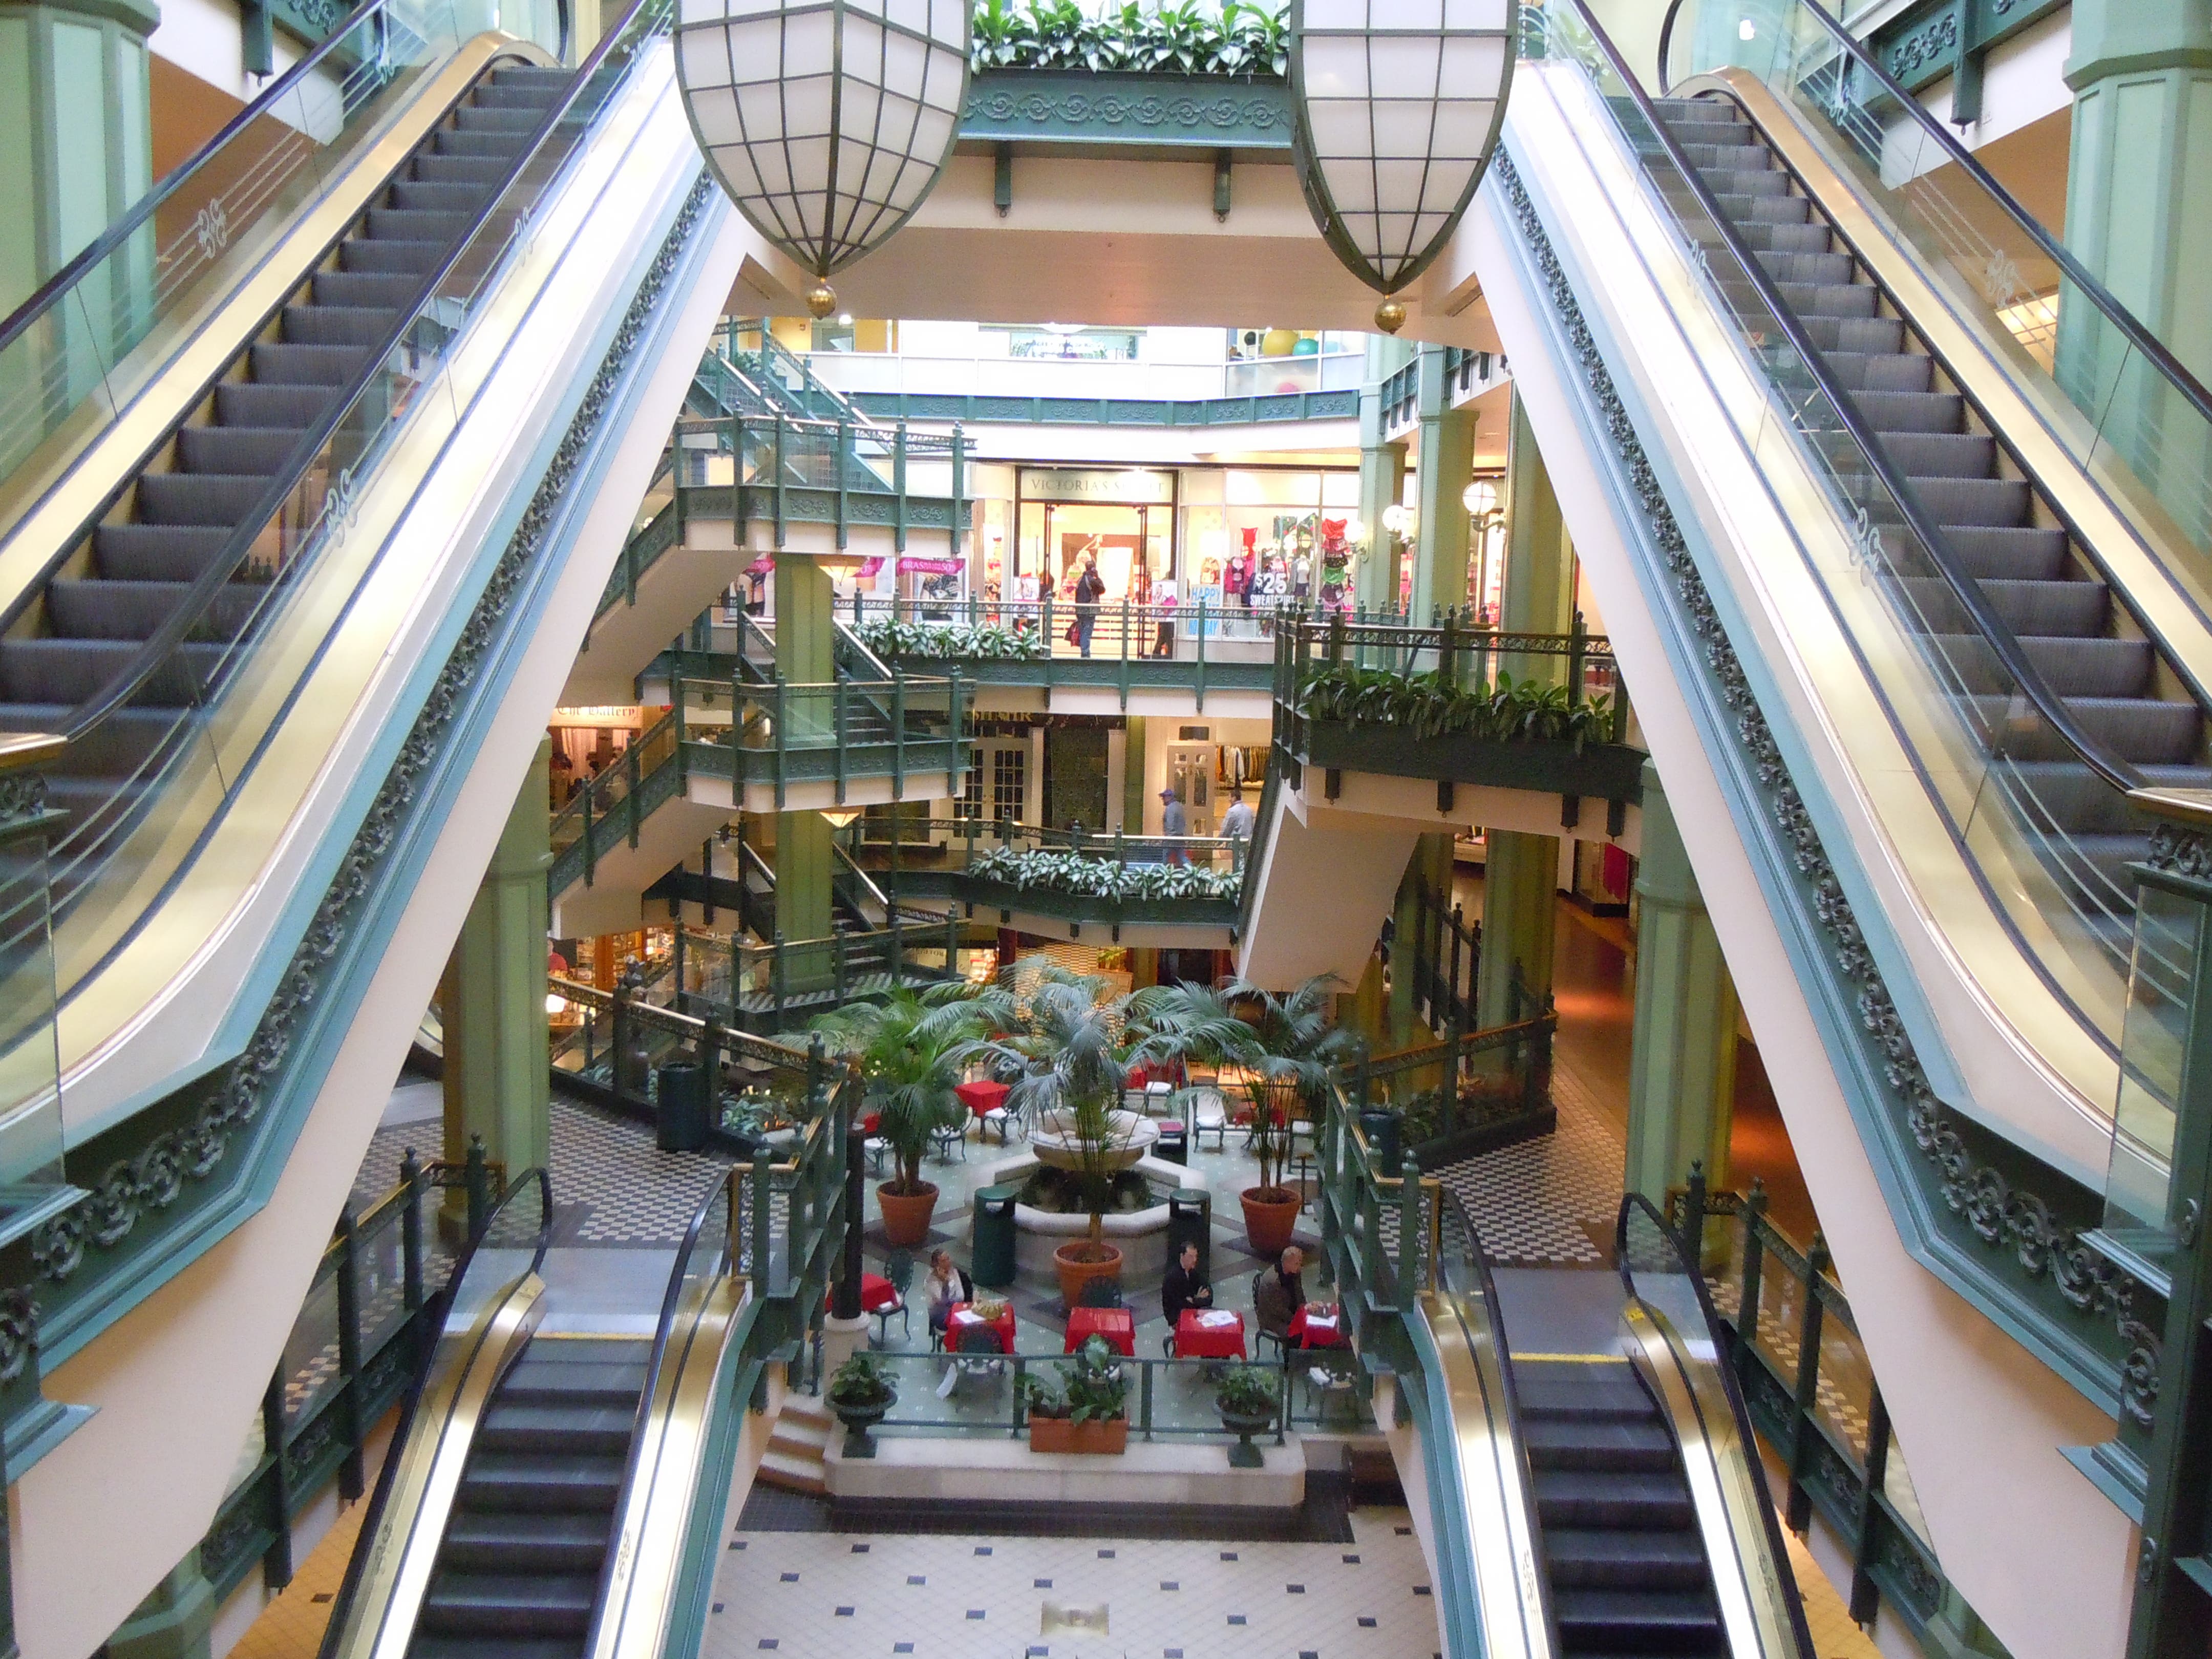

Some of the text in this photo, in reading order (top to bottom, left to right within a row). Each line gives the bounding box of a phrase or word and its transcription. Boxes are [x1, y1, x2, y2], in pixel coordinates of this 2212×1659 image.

[1031, 478, 1108, 492] VICTORIA'S
[903, 560, 924, 569] BRAS
[1256, 572, 1287, 594] $25
[1192, 587, 1220, 602] HAPPY
[1188, 620, 1218, 635] HODAY
